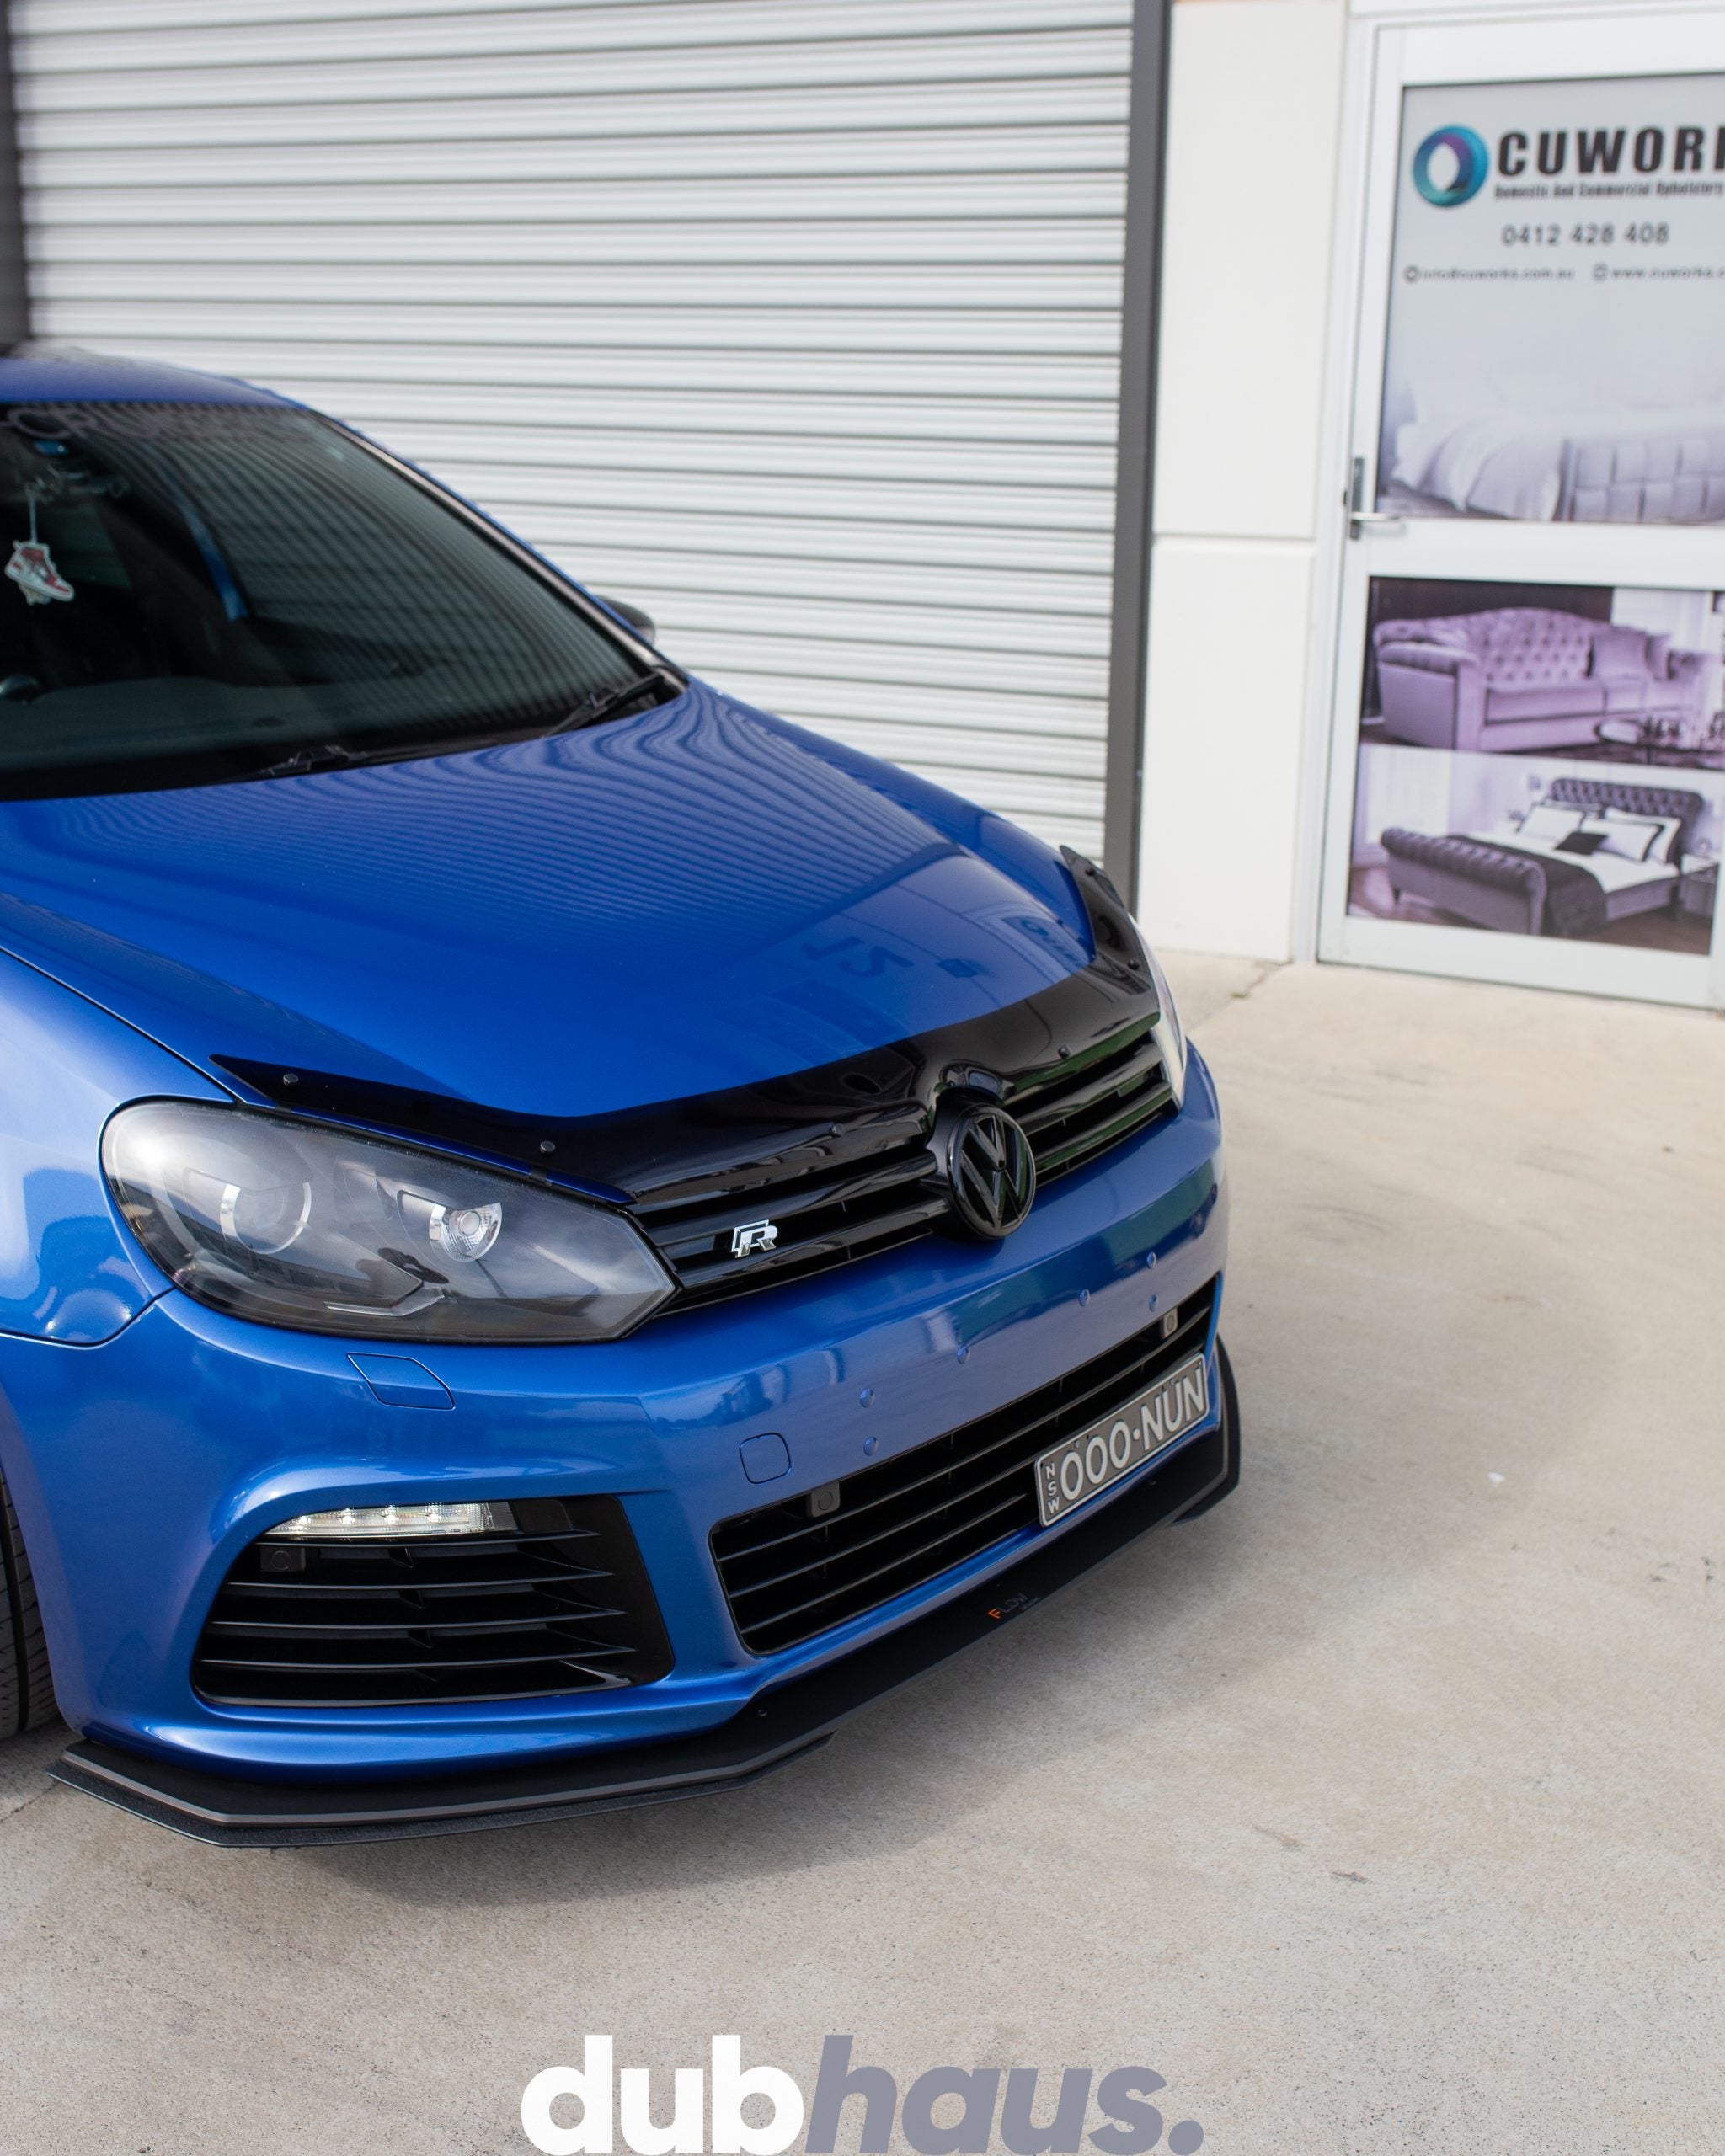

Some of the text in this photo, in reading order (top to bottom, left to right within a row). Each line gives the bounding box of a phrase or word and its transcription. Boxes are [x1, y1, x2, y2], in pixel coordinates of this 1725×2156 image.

[1502, 221, 1669, 246] 0412 428 408
